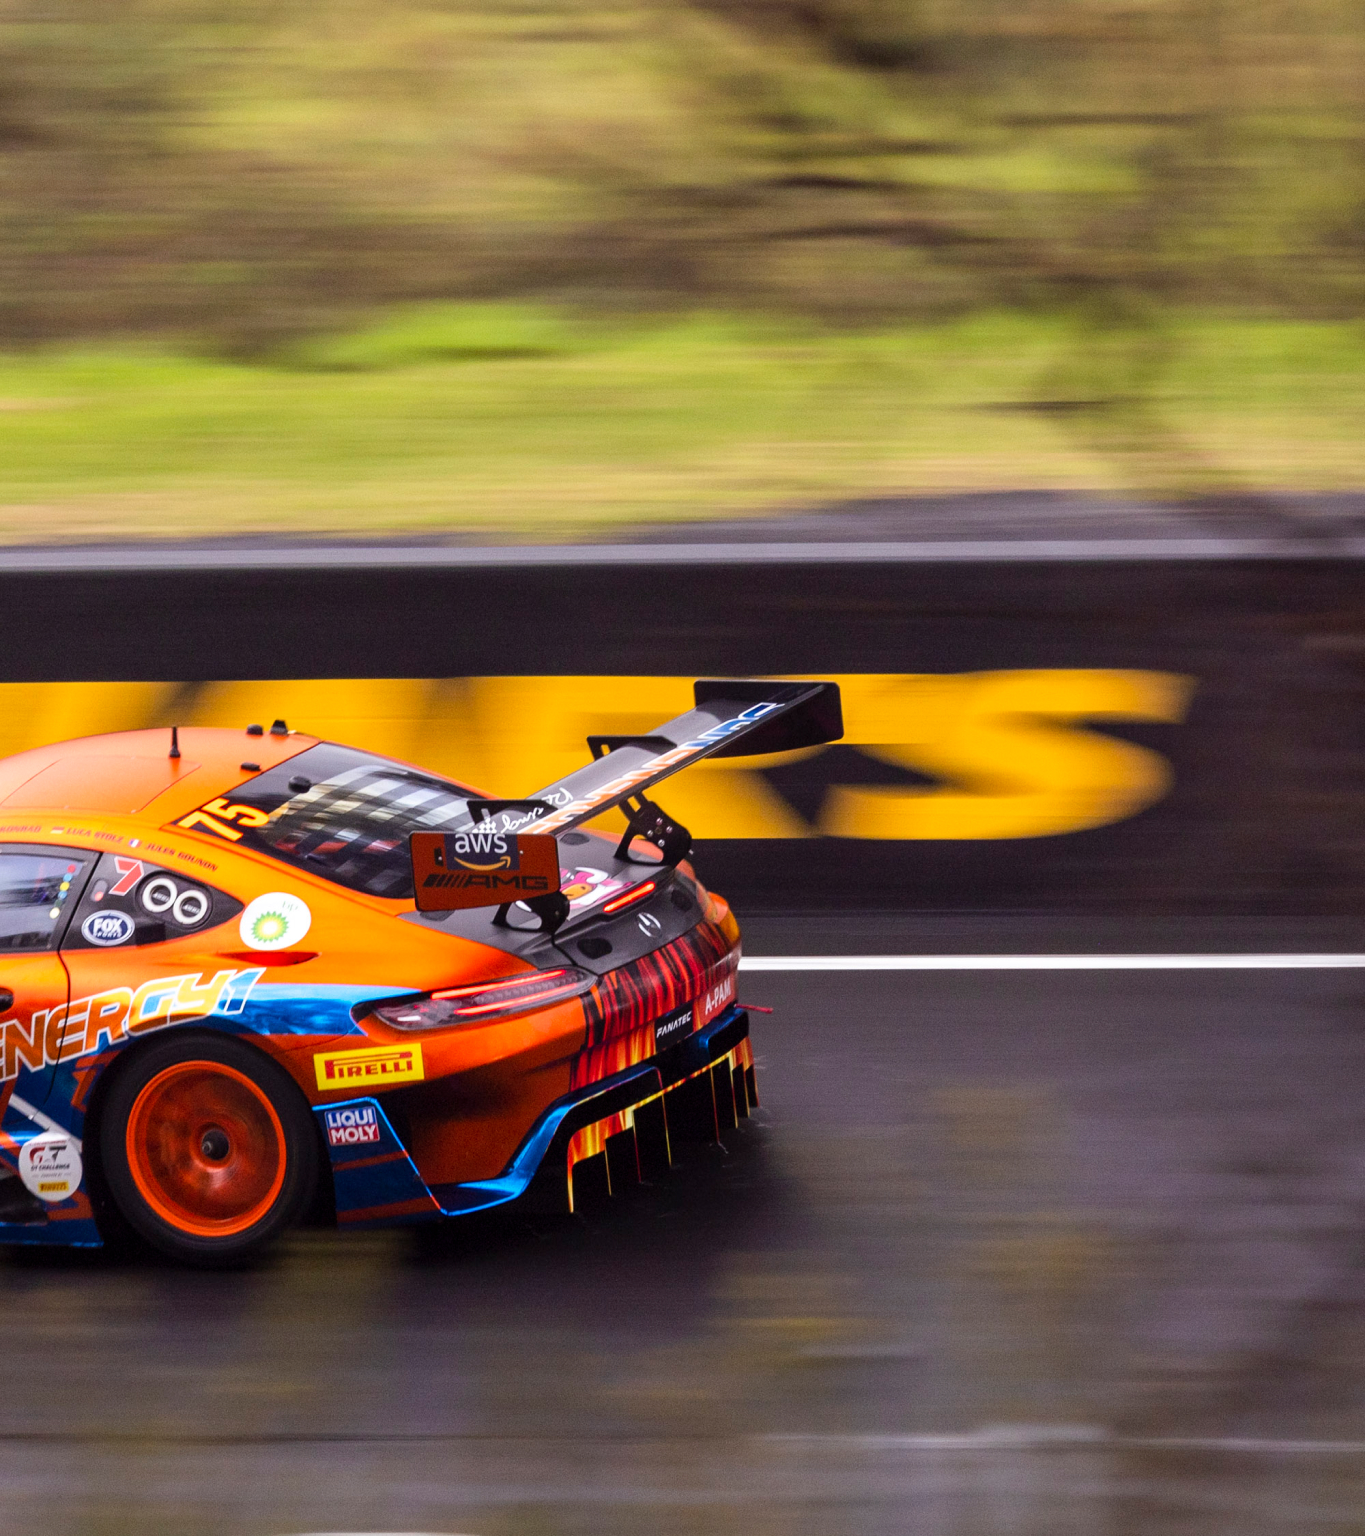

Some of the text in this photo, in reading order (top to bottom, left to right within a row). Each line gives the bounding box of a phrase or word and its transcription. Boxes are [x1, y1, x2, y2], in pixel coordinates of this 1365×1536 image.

[178, 797, 271, 842] 75
[66, 827, 125, 843] LUCA STOLZ
[454, 832, 508, 854] aws
[144, 843, 176, 856] JULES
[93, 918, 123, 935] FOX
[704, 976, 732, 1016] A-PAM
[656, 1010, 693, 1039] FANATEC
[324, 1050, 413, 1079] PIRELLI
[327, 1108, 374, 1129] LIQUI
[330, 1124, 377, 1144] MOLY
